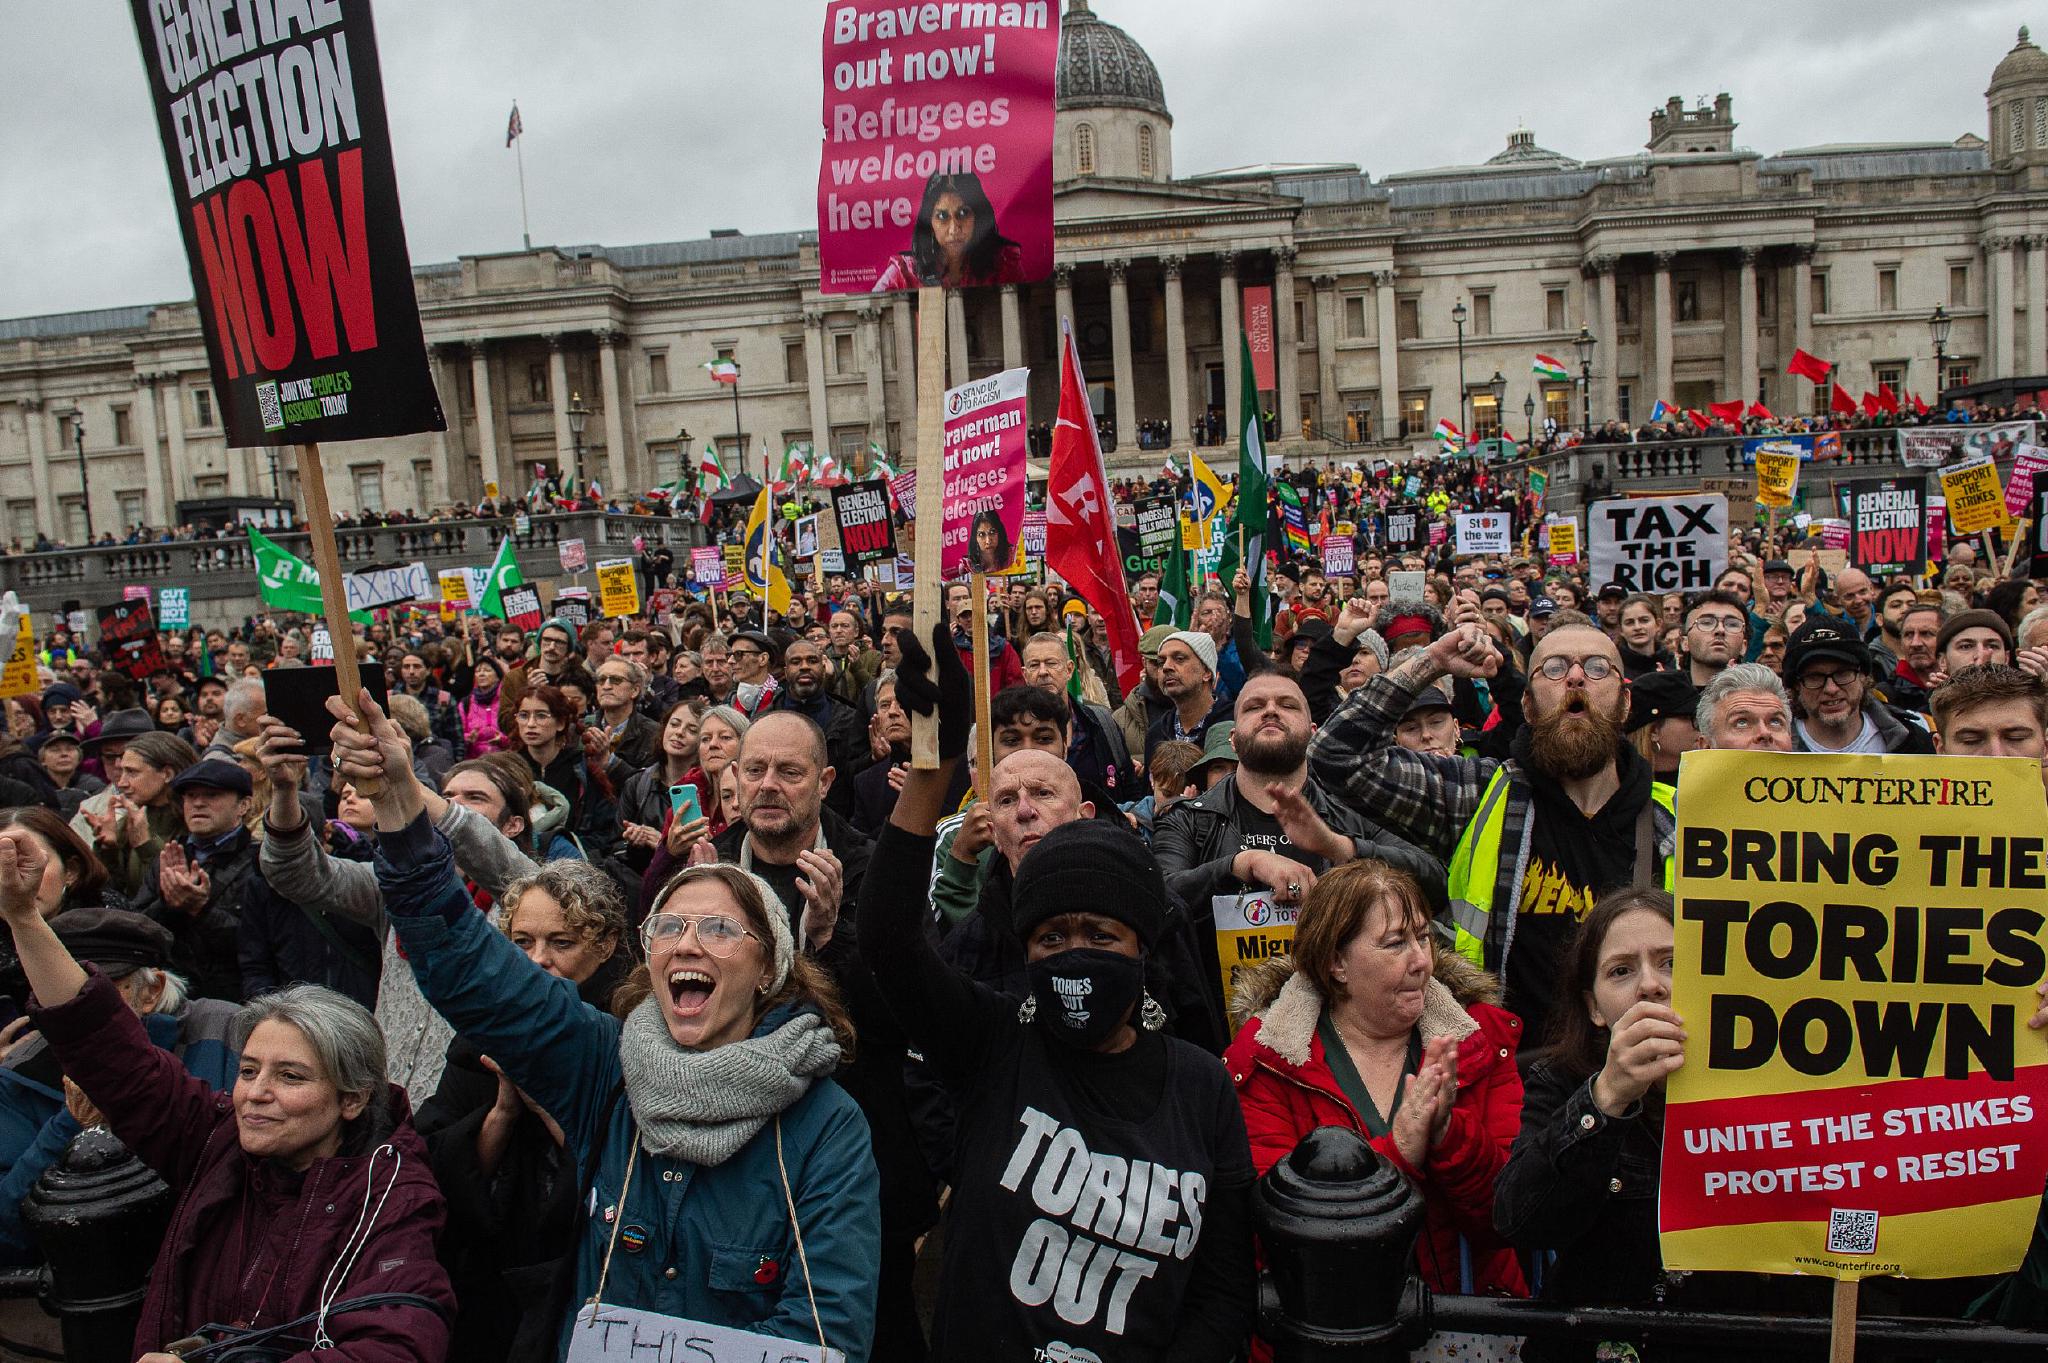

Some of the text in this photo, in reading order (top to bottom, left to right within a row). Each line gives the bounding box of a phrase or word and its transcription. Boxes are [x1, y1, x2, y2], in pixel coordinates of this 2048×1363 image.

[833, 0, 1048, 45] Braverman
[147, 0, 343, 93] GENE
[833, 34, 996, 91] out now!
[170, 31, 360, 198] ELECTION
[833, 97, 1010, 143] Refugees
[831, 143, 996, 185] welcome
[828, 193, 912, 233] here
[192, 147, 378, 379] NOW
[1252, 306, 1262, 352] NATIONAL
[1260, 304, 1270, 352] GALLERY
[280, 370, 352, 402] JOIN THE PEOPLE'S
[963, 380, 998, 400] STAND UP
[283, 393, 348, 423] ASSEMBLY TODAY
[963, 389, 1001, 410] TO RACISM
[944, 434, 1001, 472] ut now!
[1760, 453, 1794, 468] SUPPORT
[1767, 465, 1782, 477] THE
[1945, 466, 1992, 487] SUPPORT
[1955, 489, 1996, 509] STRIKES
[1962, 481, 1983, 495] THE
[837, 489, 885, 512] GENERAL
[942, 492, 1004, 522] elcome
[1858, 489, 1919, 513] GENERAL
[840, 505, 887, 527] ELECTION
[1137, 507, 1173, 523] WAGES UP
[1155, 518, 1175, 529] DOWN
[1388, 514, 1416, 525] TORIES
[1606, 503, 1720, 541] TAX
[1857, 509, 1920, 531] ELECTION
[843, 519, 889, 554] NOW
[1388, 524, 1415, 542] OUT
[1464, 530, 1503, 540] the war
[1621, 540, 1697, 559] THE
[1858, 527, 1920, 564] NOW
[272, 559, 320, 585] RM
[600, 566, 629, 578] SUPPORT
[1126, 555, 1168, 572] Gree
[1327, 559, 1353, 573] NOW
[609, 577, 623, 586] THE
[696, 570, 720, 582] NOW
[1613, 559, 1711, 592] RICH
[160, 588, 186, 599] CUT
[605, 585, 632, 597] STRIKES
[160, 599, 187, 609] WAR
[160, 608, 185, 617] NOT
[1744, 777, 1994, 807] COUNTERFIRE
[1280, 834, 1292, 845] O
[1681, 826, 2048, 890] BRING THE
[1236, 935, 1291, 960] Migr
[1681, 898, 2047, 988] TORIES
[1052, 976, 1093, 996] TORIES
[1060, 995, 1085, 1011] OUT
[1707, 993, 2016, 1082] DOWN
[1683, 1095, 2035, 1155] UNITE THE STRIKES
[1704, 1143, 2022, 1197] PROTEST RESIST
[1000, 1106, 1206, 1261] TORIES
[1794, 1255, 1901, 1272] www.counterfire.org
[1010, 1217, 1159, 1336] OUT
